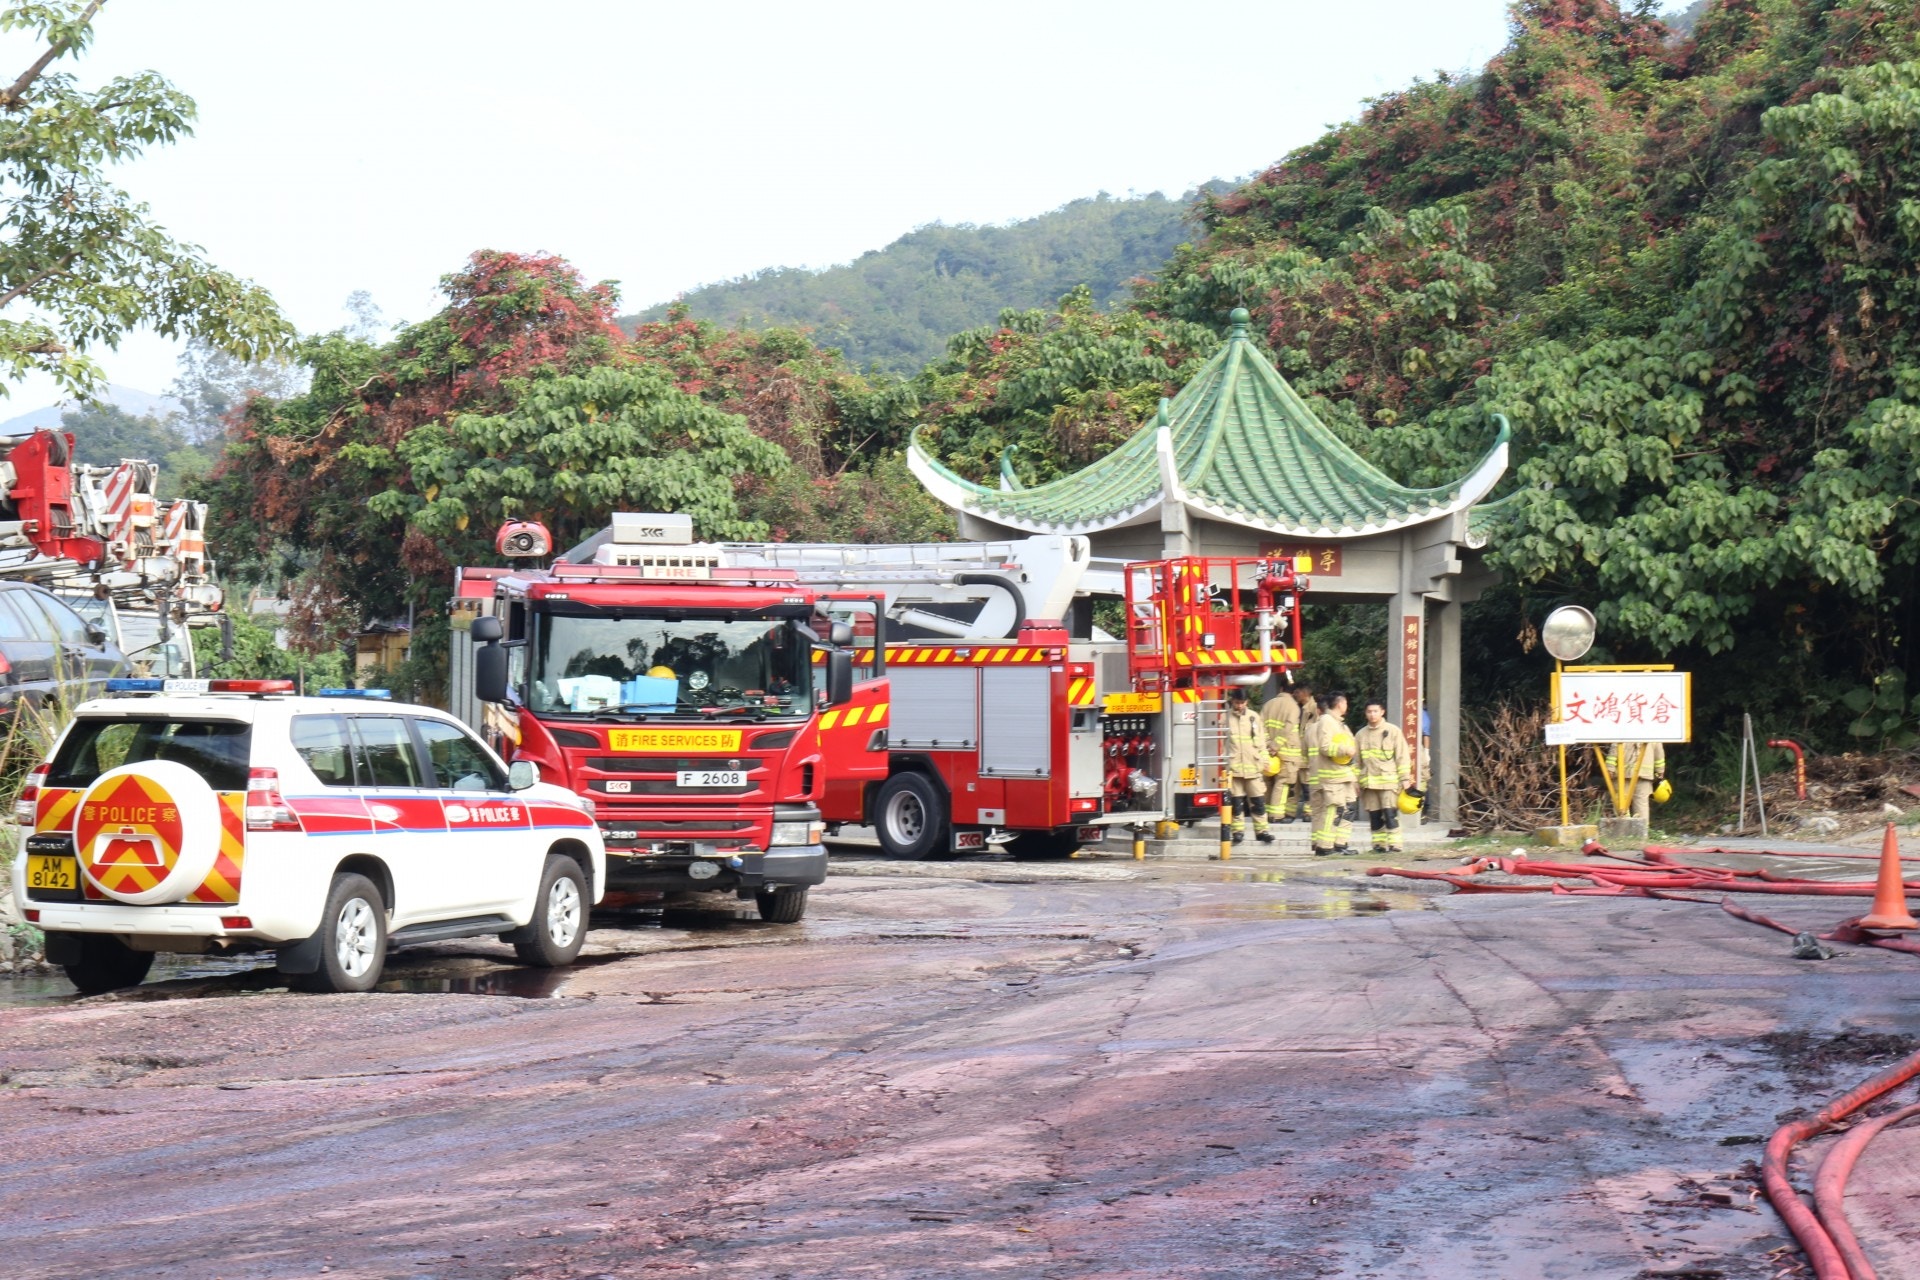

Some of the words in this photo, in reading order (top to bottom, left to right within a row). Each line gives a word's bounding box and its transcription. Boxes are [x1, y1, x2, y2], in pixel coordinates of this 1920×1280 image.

[655, 568, 697, 578] FIRE
[1564, 691, 1679, 724] 文鴻貨倉
[616, 733, 629, 748] 消
[631, 734, 657, 746] FIRE
[660, 734, 718, 747] SERVICES
[721, 734, 734, 748] 防
[683, 773, 693, 785] F
[702, 772, 740, 785] 2608
[100, 806, 157, 823] POLICE
[480, 807, 511, 822] POLICE
[42, 857, 62, 873] AM
[33, 871, 69, 888] 8142
